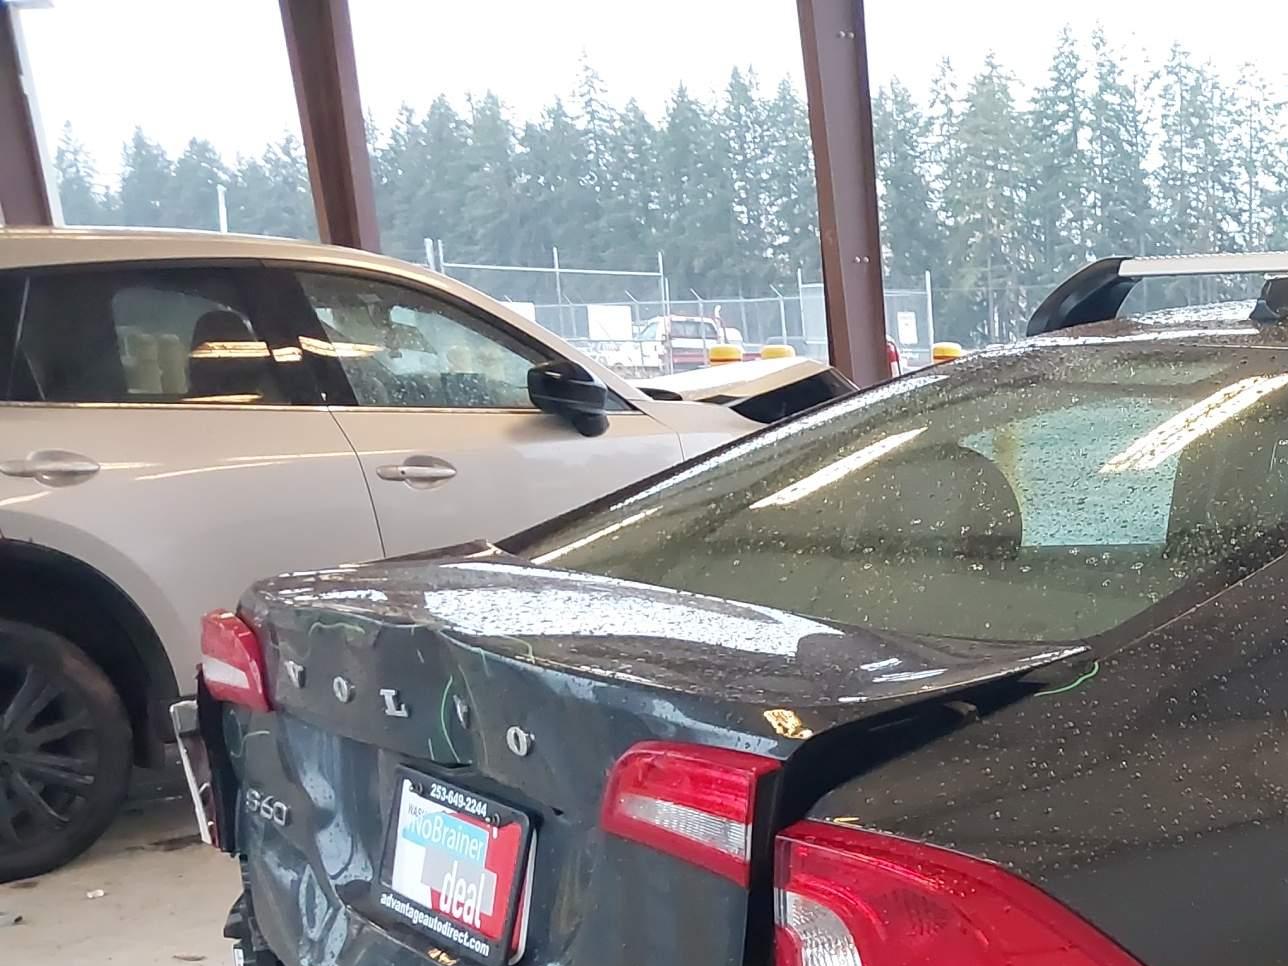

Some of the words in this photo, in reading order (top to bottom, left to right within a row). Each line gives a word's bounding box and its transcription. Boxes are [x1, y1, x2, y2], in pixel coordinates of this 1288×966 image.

[285, 660, 530, 757] VOLVO
[246, 788, 287, 826] S60
[430, 783, 488, 818] 253-649-2244
[380, 892, 490, 957] advantageautodirect.com
[440, 860, 485, 929] deal
